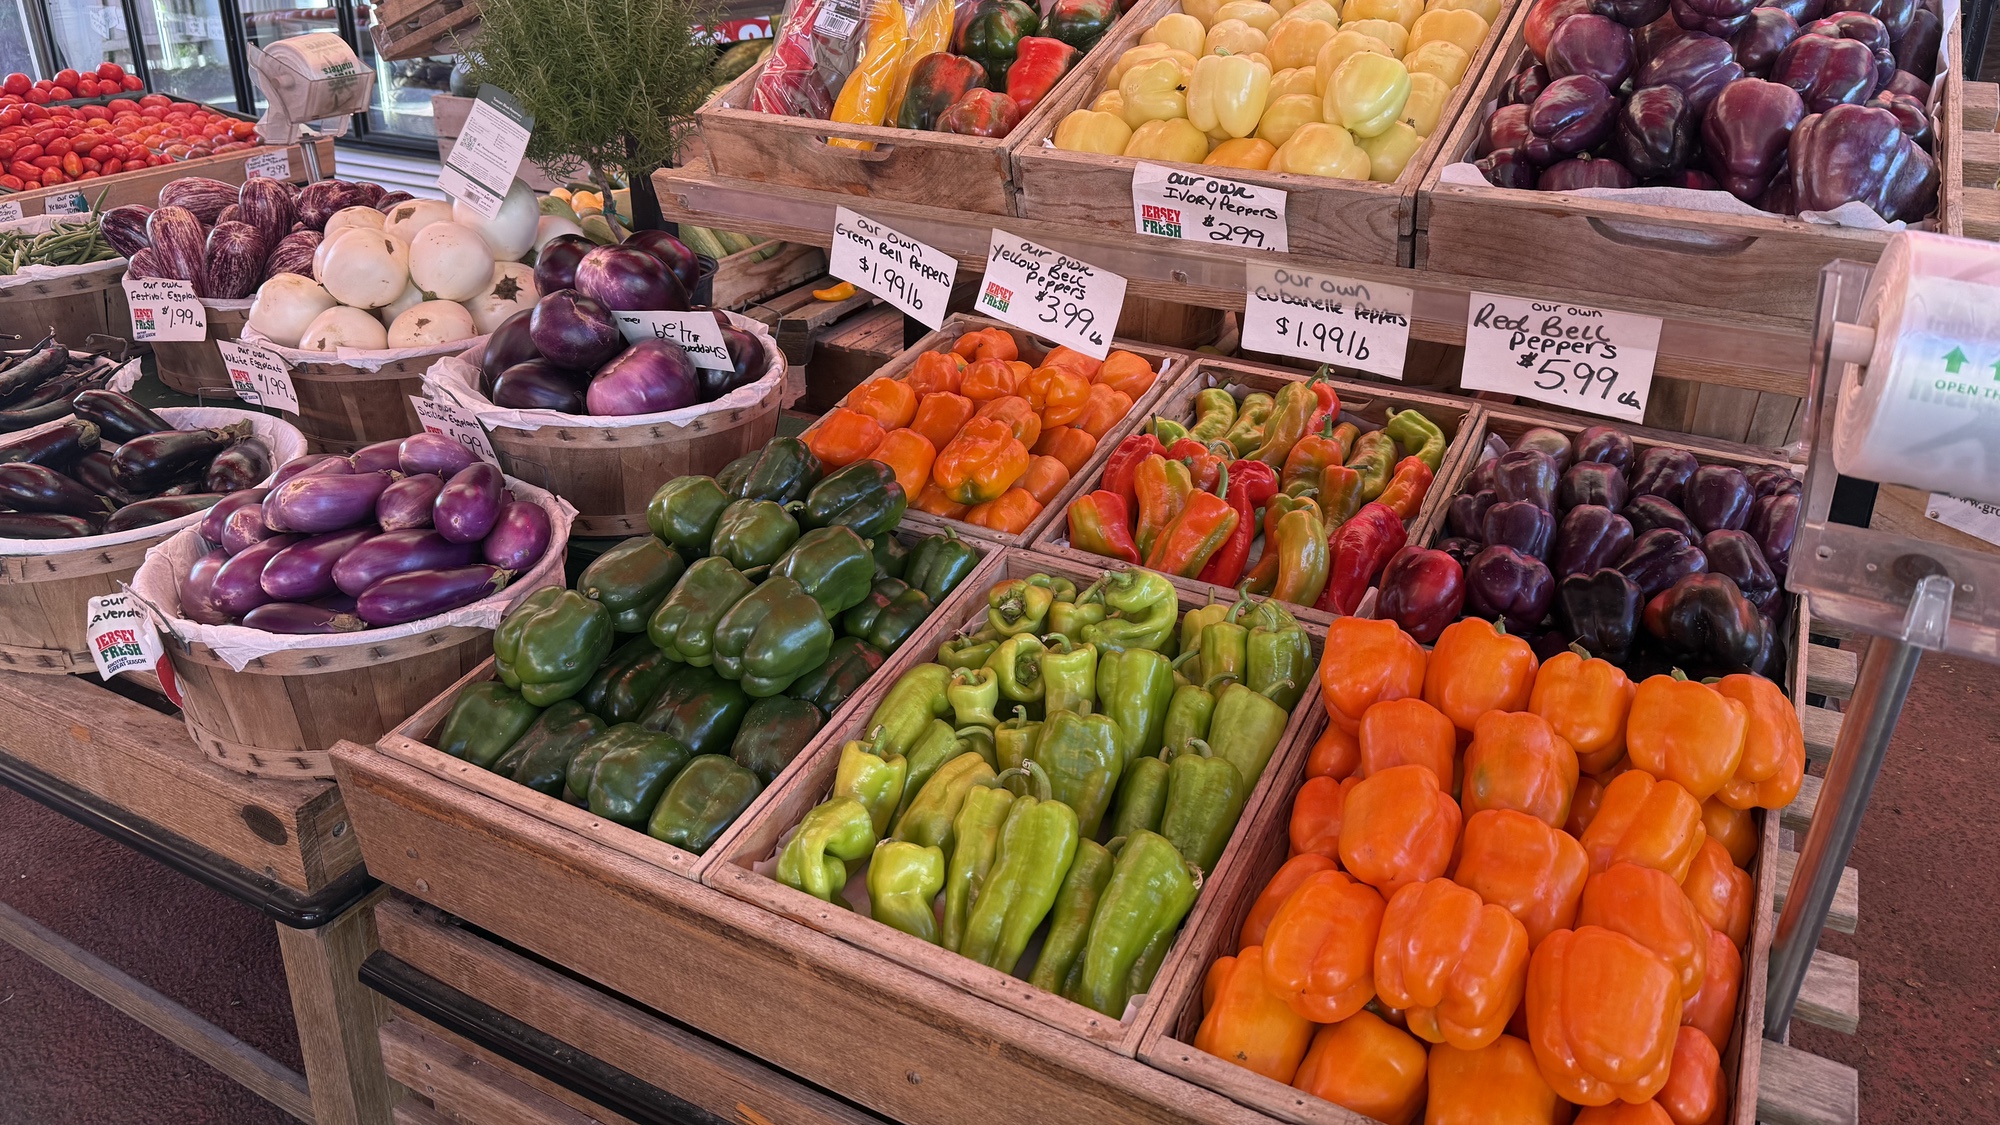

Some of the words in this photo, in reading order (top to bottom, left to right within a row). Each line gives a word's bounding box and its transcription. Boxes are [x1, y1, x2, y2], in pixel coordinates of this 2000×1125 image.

[1142, 204, 1181, 222] JERSEY
[1220, 195, 1278, 220] Peppers
[1142, 219, 1182, 238] FRESH
[836, 223, 874, 250] Green
[879, 242, 903, 264] Bell
[910, 255, 950, 288] Peppers
[992, 244, 1040, 271] Yellow
[1048, 264, 1086, 288] Bell
[131, 290, 164, 301] Festival
[986, 281, 1014, 301] JERSEY
[134, 308, 153, 318] JERSEY
[982, 293, 1010, 313] FRESH
[1255, 285, 1343, 315] Cubanelle
[1355, 302, 1408, 328] Peppers
[135, 320, 155, 330] FRESH
[162, 306, 194, 328] $1.99
[1473, 303, 1529, 333] Red
[1540, 315, 1610, 342] Bell
[223, 353, 248, 366] White
[258, 373, 288, 398] $1.99
[1517, 352, 1619, 400] $5.99
[1935, 379, 1979, 396] OPEN
[418, 406, 447, 421] Sicilian
[89, 608, 145, 628] avender
[95, 629, 137, 651] JERSEY
[100, 643, 143, 663] FRESH
[109, 661, 126, 674] GREAT
[127, 658, 147, 666] SEASON
